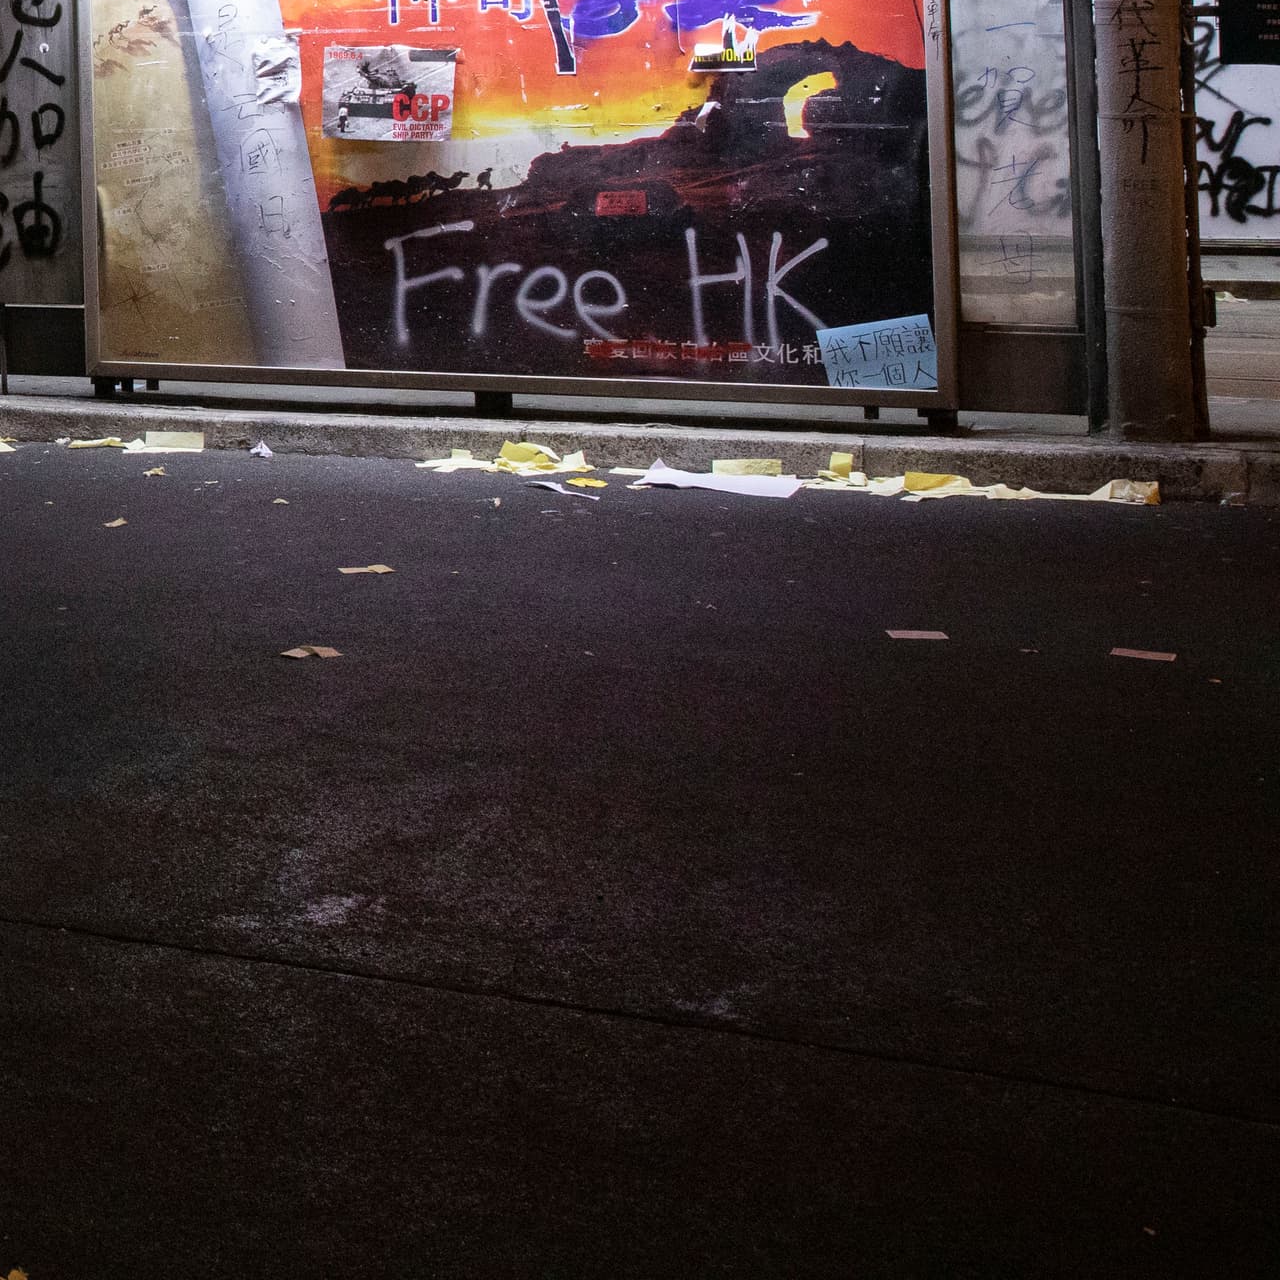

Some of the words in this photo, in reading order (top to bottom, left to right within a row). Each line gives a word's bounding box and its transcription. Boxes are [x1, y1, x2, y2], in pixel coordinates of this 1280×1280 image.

[392, 93, 451, 122] CCP
[410, 131, 434, 140] PARTY
[386, 221, 627, 348] Free
[684, 227, 830, 352] HK
[825, 324, 935, 366] 我不願讓
